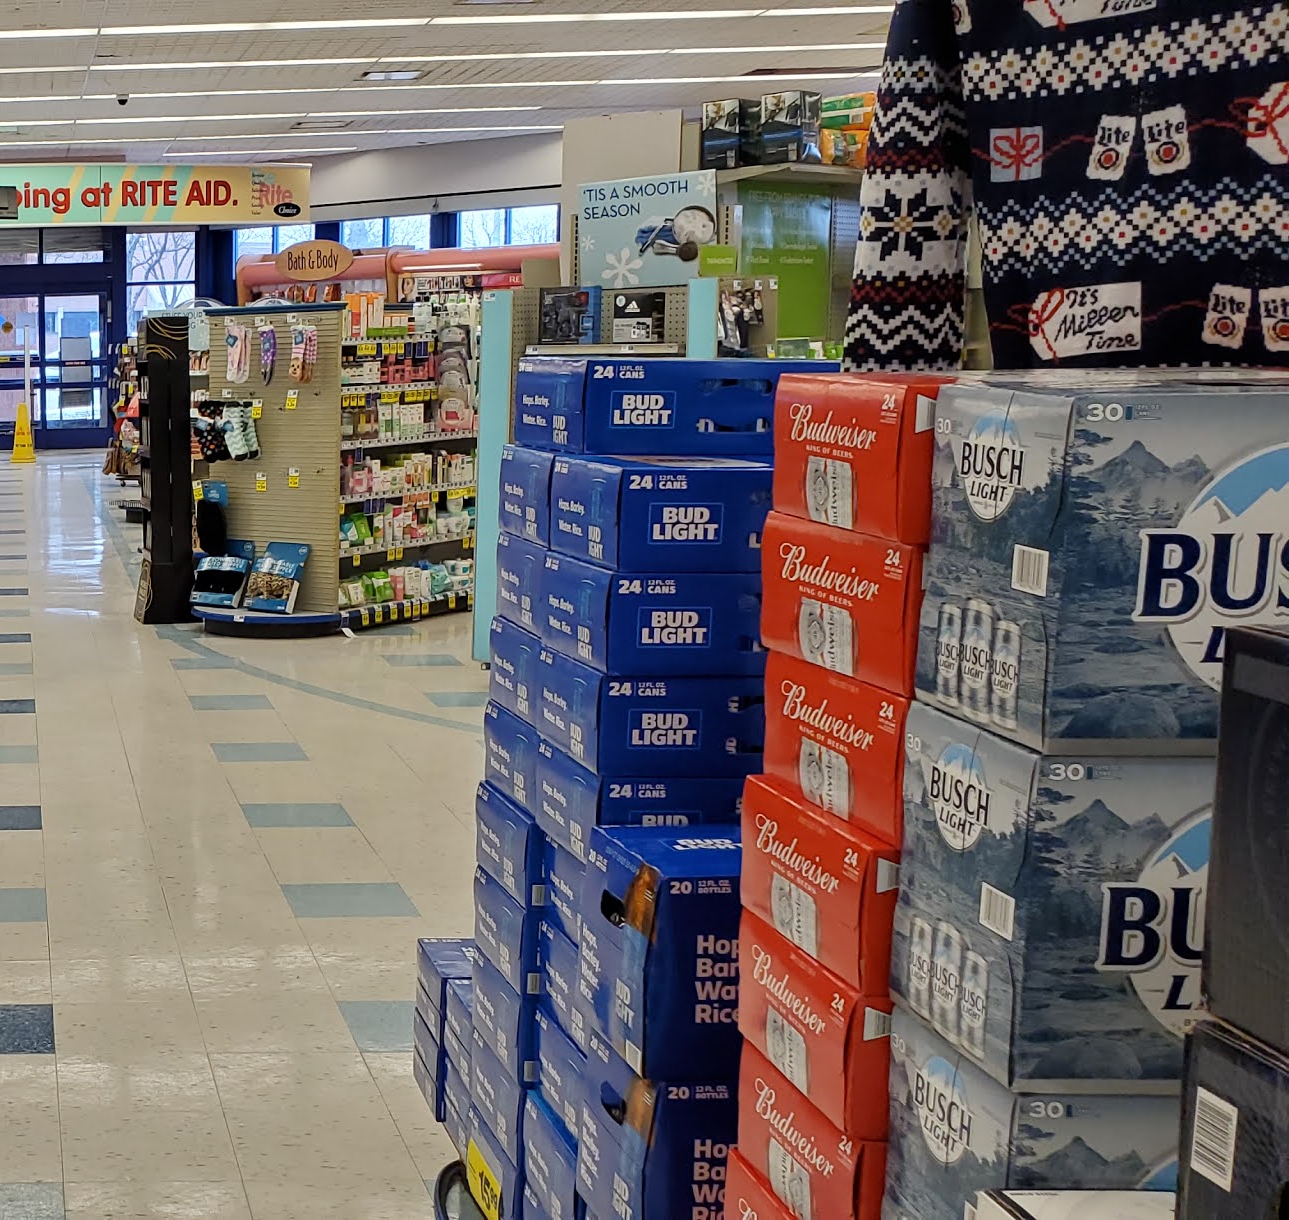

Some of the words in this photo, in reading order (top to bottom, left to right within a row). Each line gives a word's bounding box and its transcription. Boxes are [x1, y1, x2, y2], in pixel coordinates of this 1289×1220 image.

[1097, 126, 1130, 147] Lite
[1146, 119, 1185, 144] Lite
[81, 183, 114, 207] at
[121, 180, 178, 207] RITE
[185, 179, 239, 207] AID.
[610, 187, 620, 200] A
[623, 180, 689, 199] SMOOTH
[583, 203, 641, 220] SEASON
[287, 252, 307, 270] Bath
[308, 252, 315, 270] &
[316, 249, 339, 271] Body
[1212, 293, 1246, 315] Lite
[1263, 298, 1289, 319] Lit
[593, 366, 614, 379] 24
[619, 371, 645, 379] CANS
[622, 394, 665, 410] BUD
[881, 394, 897, 411] 24
[613, 409, 672, 425] LIGHT
[1086, 403, 1123, 422] 30
[789, 403, 877, 450] Budweiser
[937, 418, 952, 434] 30
[961, 440, 1024, 487] BUSCH
[629, 475, 653, 490] 24
[659, 481, 688, 490] CANS
[969, 481, 1008, 503] LIGHT
[662, 507, 710, 524] BUD
[652, 523, 719, 541] LIGHT
[884, 549, 901, 566] 24
[779, 542, 880, 601] Budweiser
[618, 580, 642, 594] 24
[648, 586, 677, 595] CANS
[651, 611, 699, 628] BUD
[641, 627, 707, 644] LIGHT
[964, 665, 984, 681] LIGHT
[994, 677, 1013, 691] LIGHT
[609, 682, 632, 696] 24
[638, 688, 667, 696] CANS
[781, 679, 874, 750] Budweiser
[878, 701, 894, 719] 24
[641, 713, 689, 730] BUD
[631, 729, 697, 746] LIGHT
[906, 733, 921, 752] 30
[1048, 763, 1085, 781] 30
[609, 784, 633, 798] 24
[638, 790, 666, 798] CANS
[929, 766, 991, 828] BUSCH
[642, 815, 688, 827] BUD
[939, 809, 976, 837] LIGHT
[755, 813, 840, 894] Budweiser
[843, 848, 858, 867] 24
[669, 881, 693, 895] 20
[751, 944, 826, 1035] Budweiser
[830, 993, 845, 1012] 24
[891, 1030, 906, 1053] 30
[668, 1086, 690, 1100] 20
[914, 1072, 973, 1149] BUSCH
[1028, 1101, 1064, 1118] 30
[754, 1077, 835, 1177] Budweiser
[838, 1135, 853, 1155] 24
[923, 1119, 959, 1154] LIGHT
